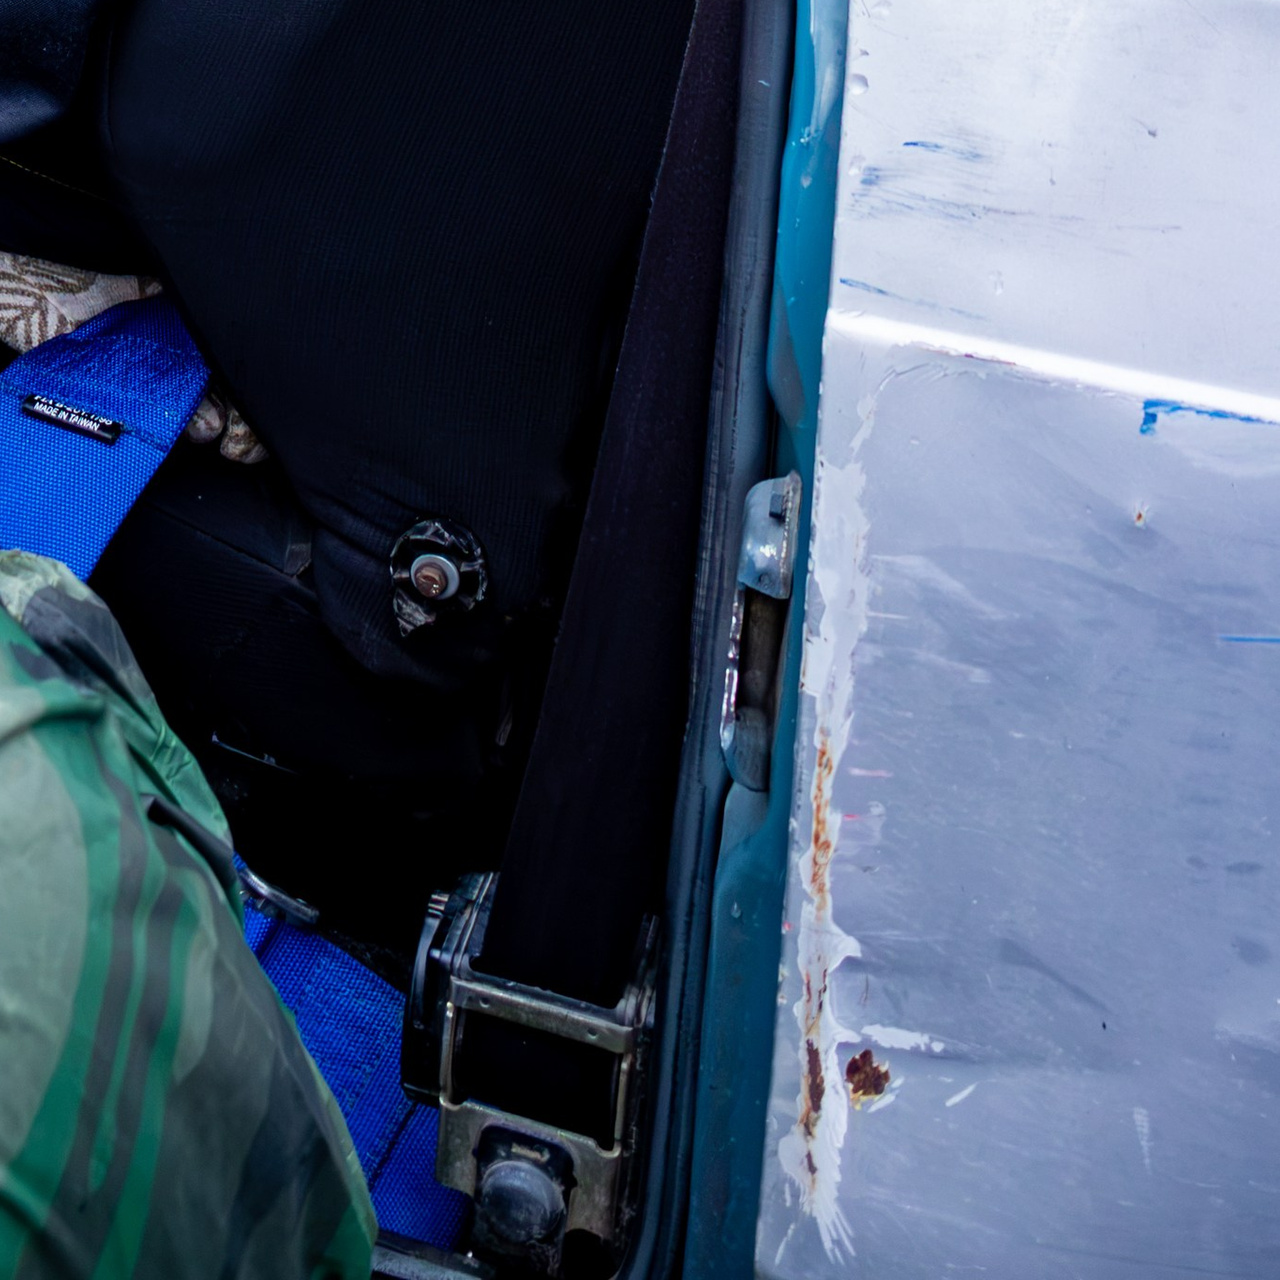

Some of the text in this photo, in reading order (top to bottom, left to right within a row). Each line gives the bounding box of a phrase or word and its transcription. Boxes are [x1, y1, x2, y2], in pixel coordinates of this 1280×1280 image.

[33, 401, 60, 418] MADE
[57, 409, 69, 421] IN
[68, 413, 101, 432] TAIWAN
